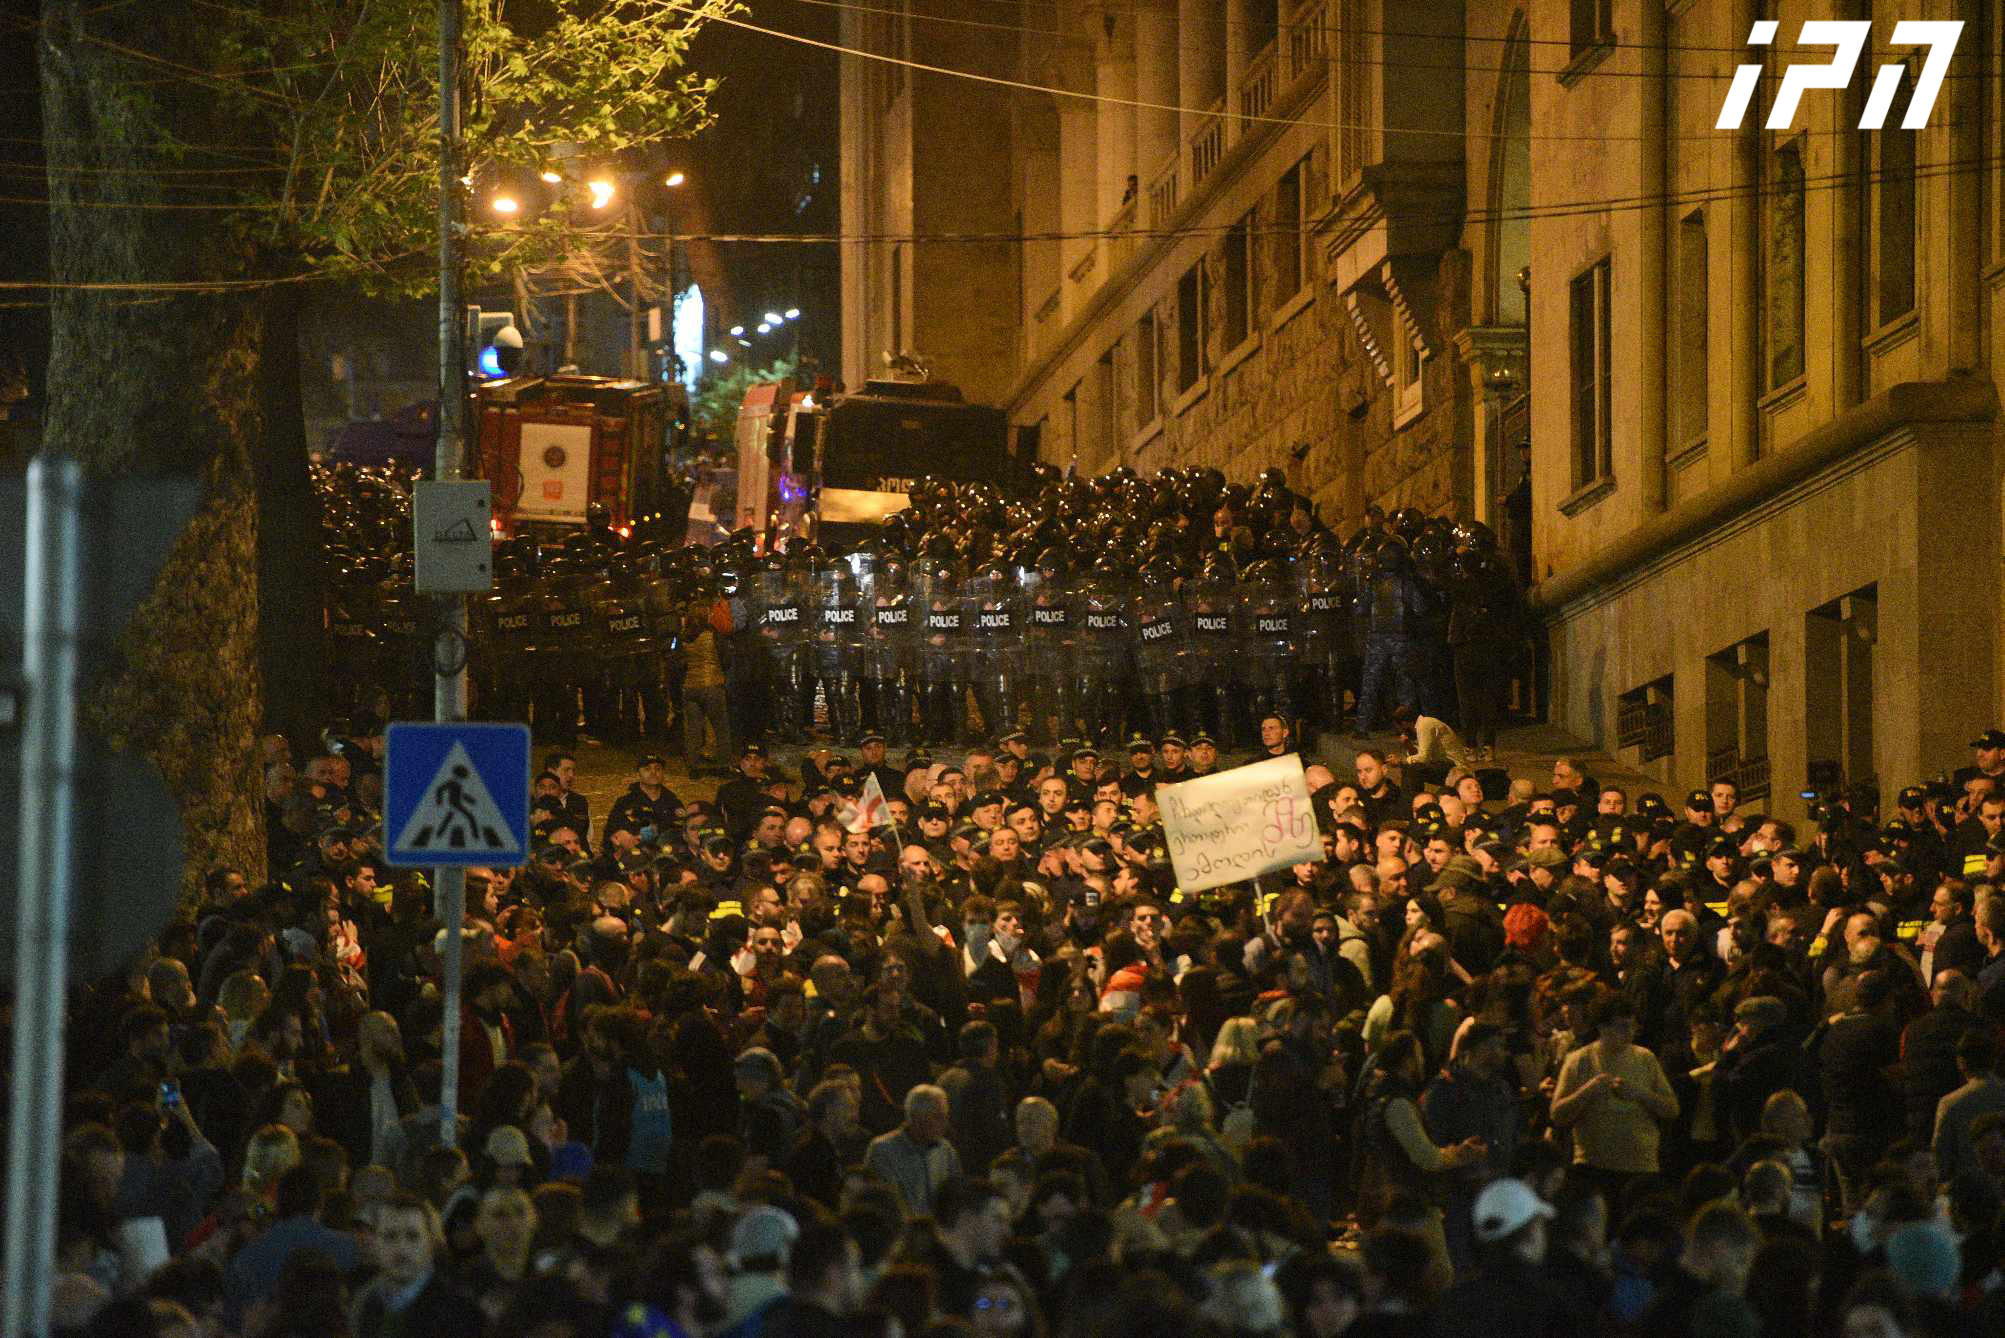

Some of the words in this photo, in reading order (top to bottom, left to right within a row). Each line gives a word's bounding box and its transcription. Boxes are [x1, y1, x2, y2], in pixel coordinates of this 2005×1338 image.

[1312, 596, 1342, 609] POLICE
[498, 614, 528, 628] POLICE
[551, 613, 581, 626] POLICE
[768, 608, 798, 622] POLICE
[825, 609, 855, 622] POLICE
[879, 610, 908, 623] POLICE
[929, 615, 960, 628] POLICE
[981, 614, 1010, 627] POLICE
[1035, 610, 1065, 622] POLICE
[1088, 615, 1117, 627] POLICE
[609, 616, 640, 631] POLICE
[1197, 617, 1227, 630] POLICE
[1260, 619, 1288, 631] POLICE
[1142, 622, 1172, 640] POLICE
